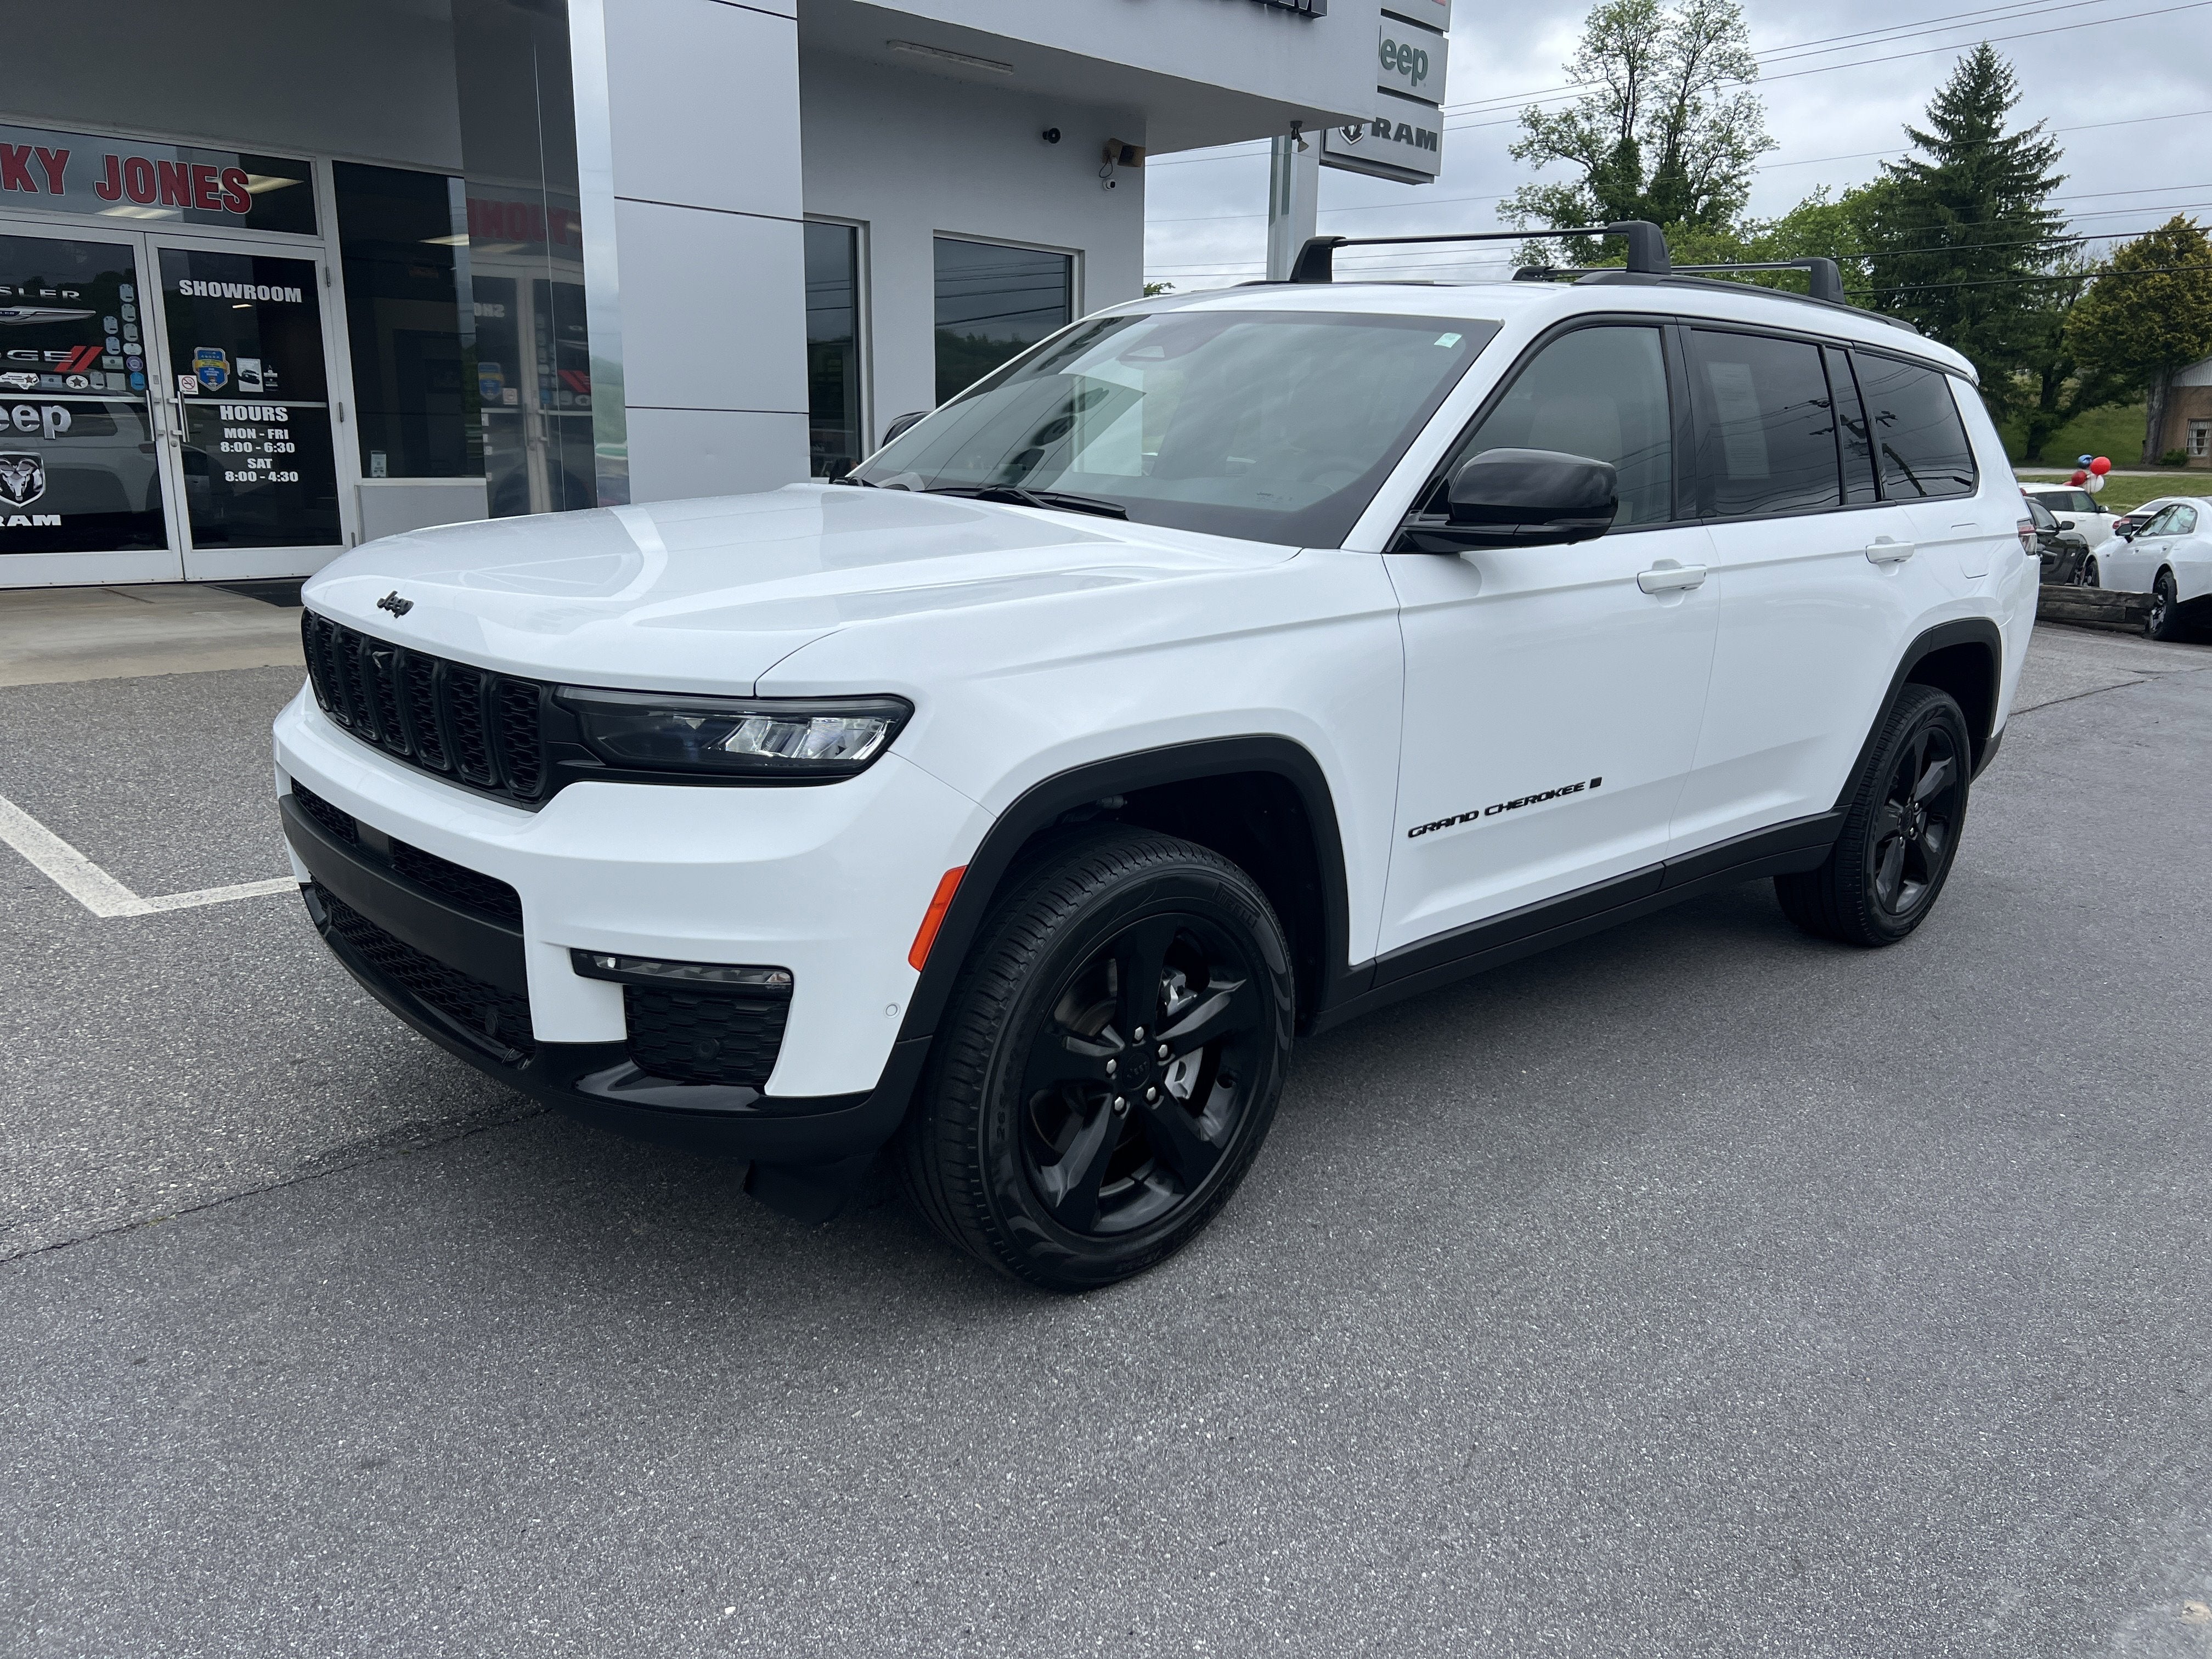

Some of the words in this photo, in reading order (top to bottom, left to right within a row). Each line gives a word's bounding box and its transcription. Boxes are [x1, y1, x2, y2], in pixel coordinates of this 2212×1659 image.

[1379, 25, 1428, 86] eep
[1372, 117, 1437, 152] RAM
[0, 142, 71, 196] KY
[94, 154, 252, 215] JONES
[0, 286, 82, 301] SLER
[179, 279, 302, 303] SHOWROOM
[0, 350, 74, 362] GE
[219, 405, 289, 422] HOURS
[224, 427, 257, 439] MON
[267, 428, 289, 439] FRI
[220, 441, 253, 453] 8:00
[263, 442, 295, 453] 6:30
[247, 458, 273, 469] SAT
[224, 471, 257, 482] 8:00
[268, 471, 298, 482] 4:30
[0, 514, 61, 527] AM
[376, 590, 414, 619] Jeep
[1408, 810, 1479, 838] GRAND
[1484, 781, 1586, 816] CHEROKEE
